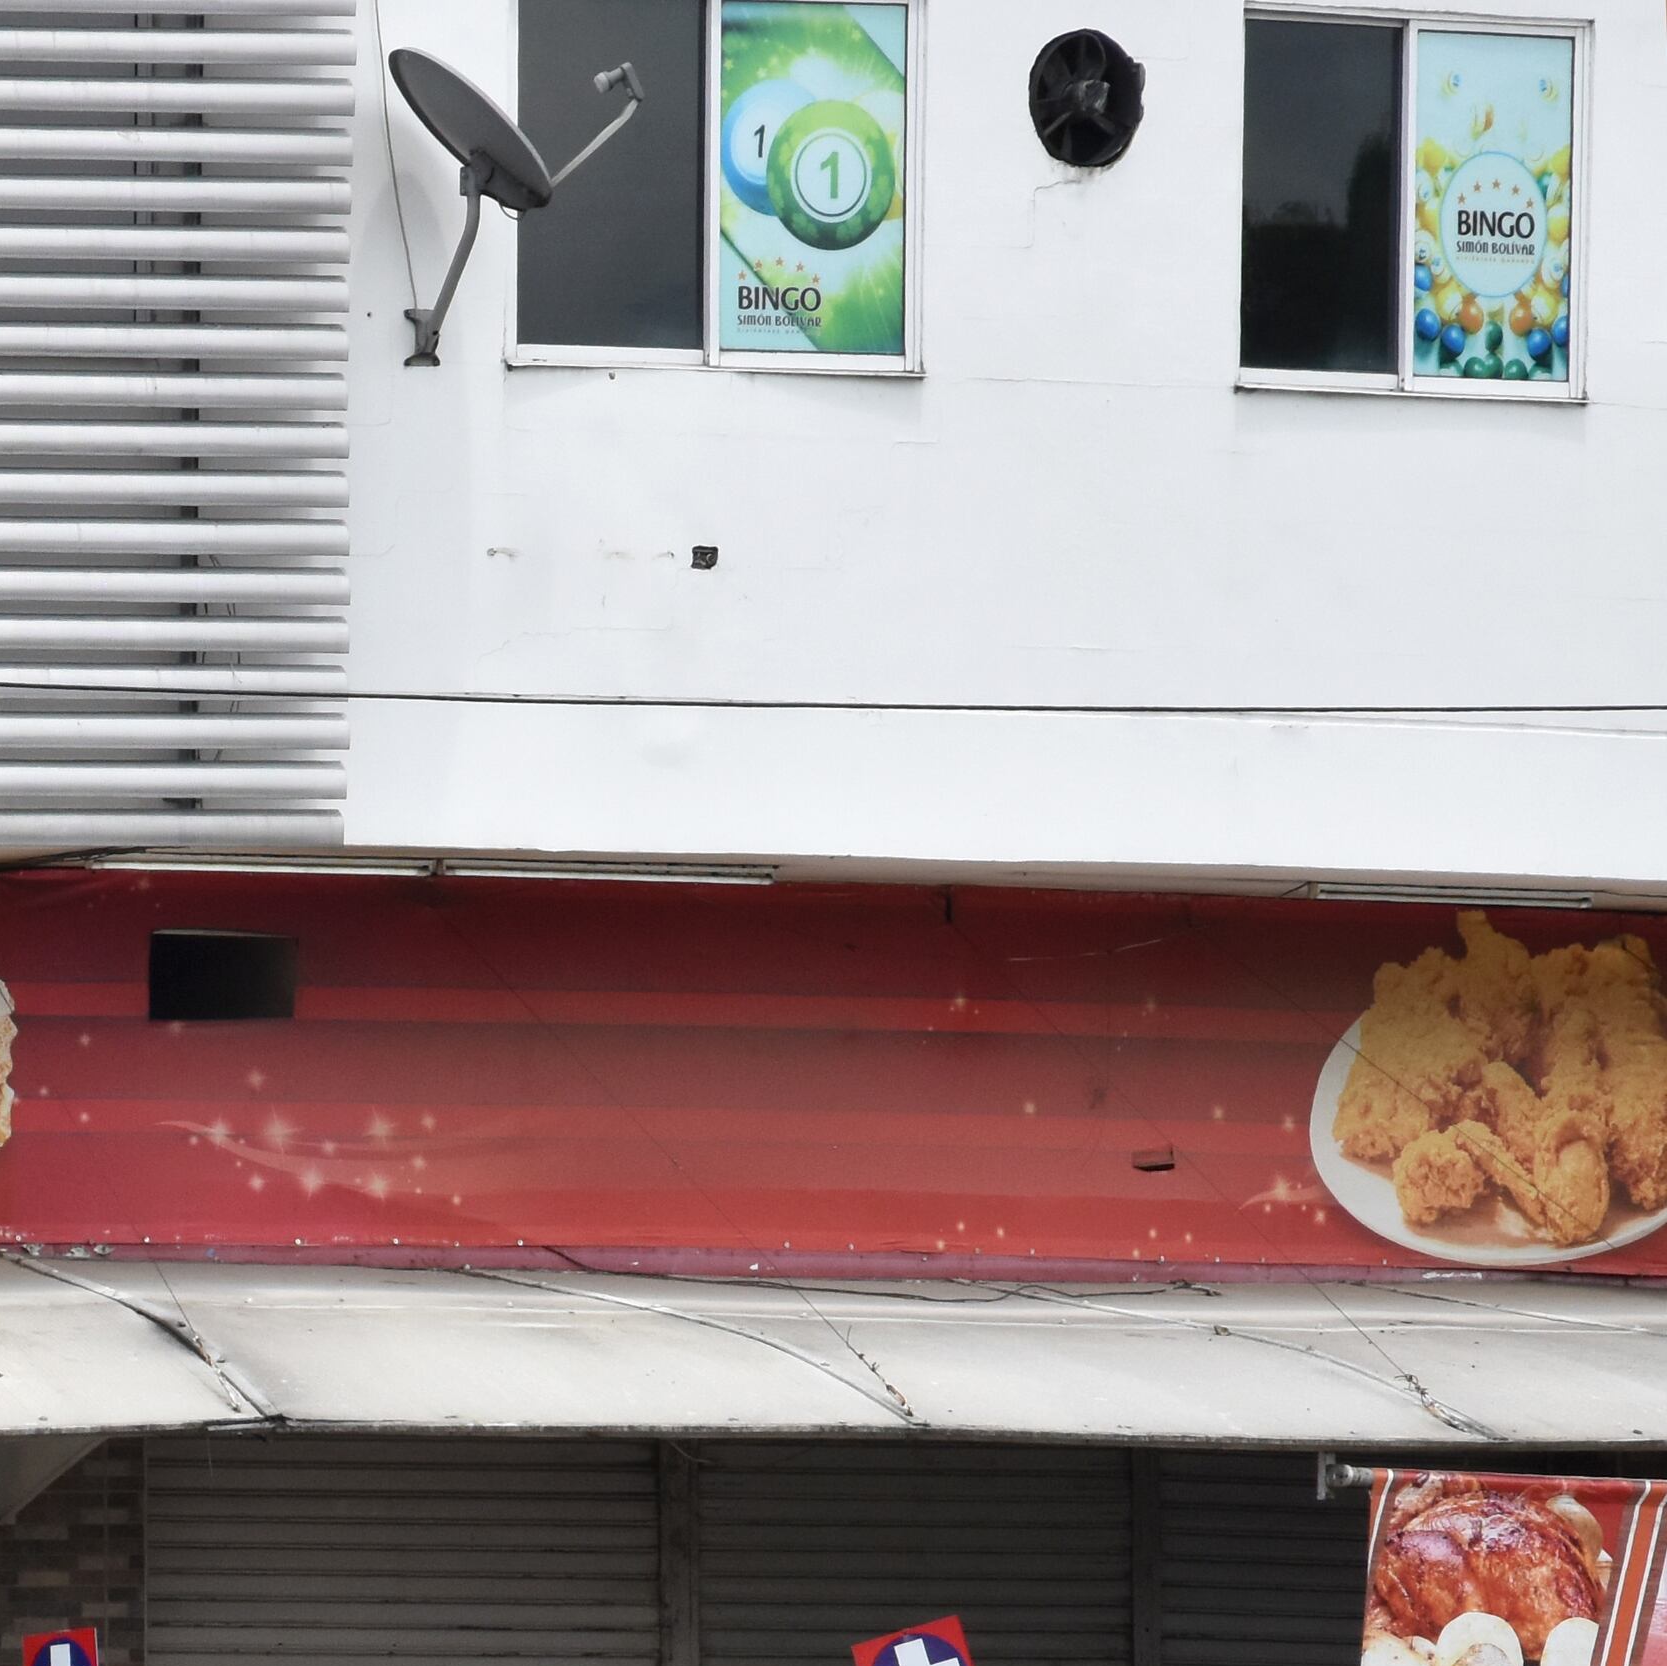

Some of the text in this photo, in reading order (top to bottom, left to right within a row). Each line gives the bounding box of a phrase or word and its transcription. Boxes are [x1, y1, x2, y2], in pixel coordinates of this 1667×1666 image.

[819, 150, 840, 200] 1
[1457, 210, 1535, 239] BINGO
[1456, 239, 1535, 256] SIMÓN BOLÍVAR
[737, 285, 822, 312] BINGO
[737, 312, 773, 327] SIMÓN
